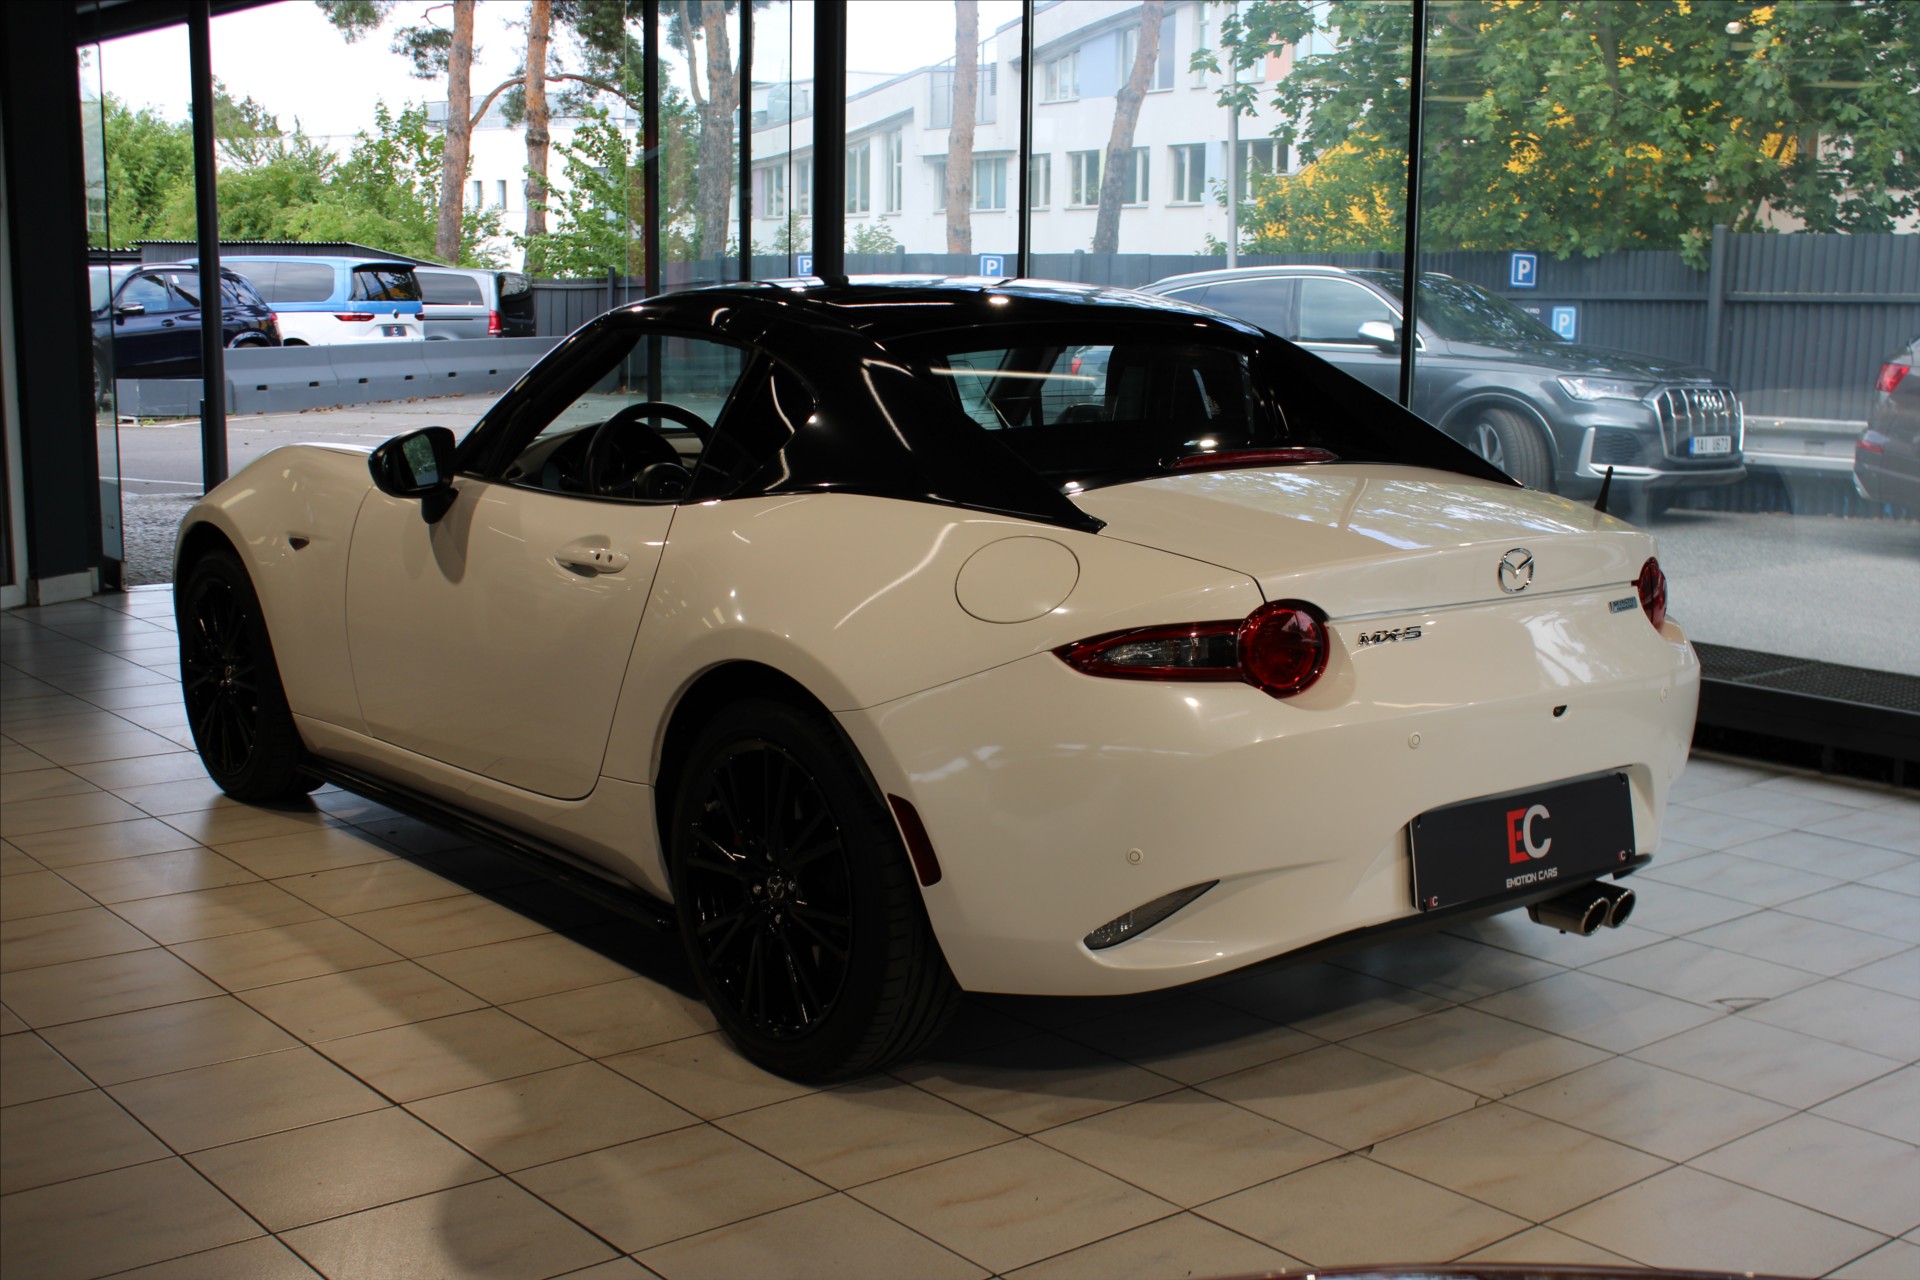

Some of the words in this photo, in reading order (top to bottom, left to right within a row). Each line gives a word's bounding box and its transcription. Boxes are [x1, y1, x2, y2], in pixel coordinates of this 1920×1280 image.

[803, 259, 812, 273] P
[986, 260, 998, 275] P
[1517, 259, 1531, 281] P
[1559, 313, 1570, 333] P
[1358, 625, 1422, 645] MX-5
[1506, 804, 1552, 864] EC
[1506, 872, 1537, 888] EMOTION
[1538, 867, 1558, 880] CARS
